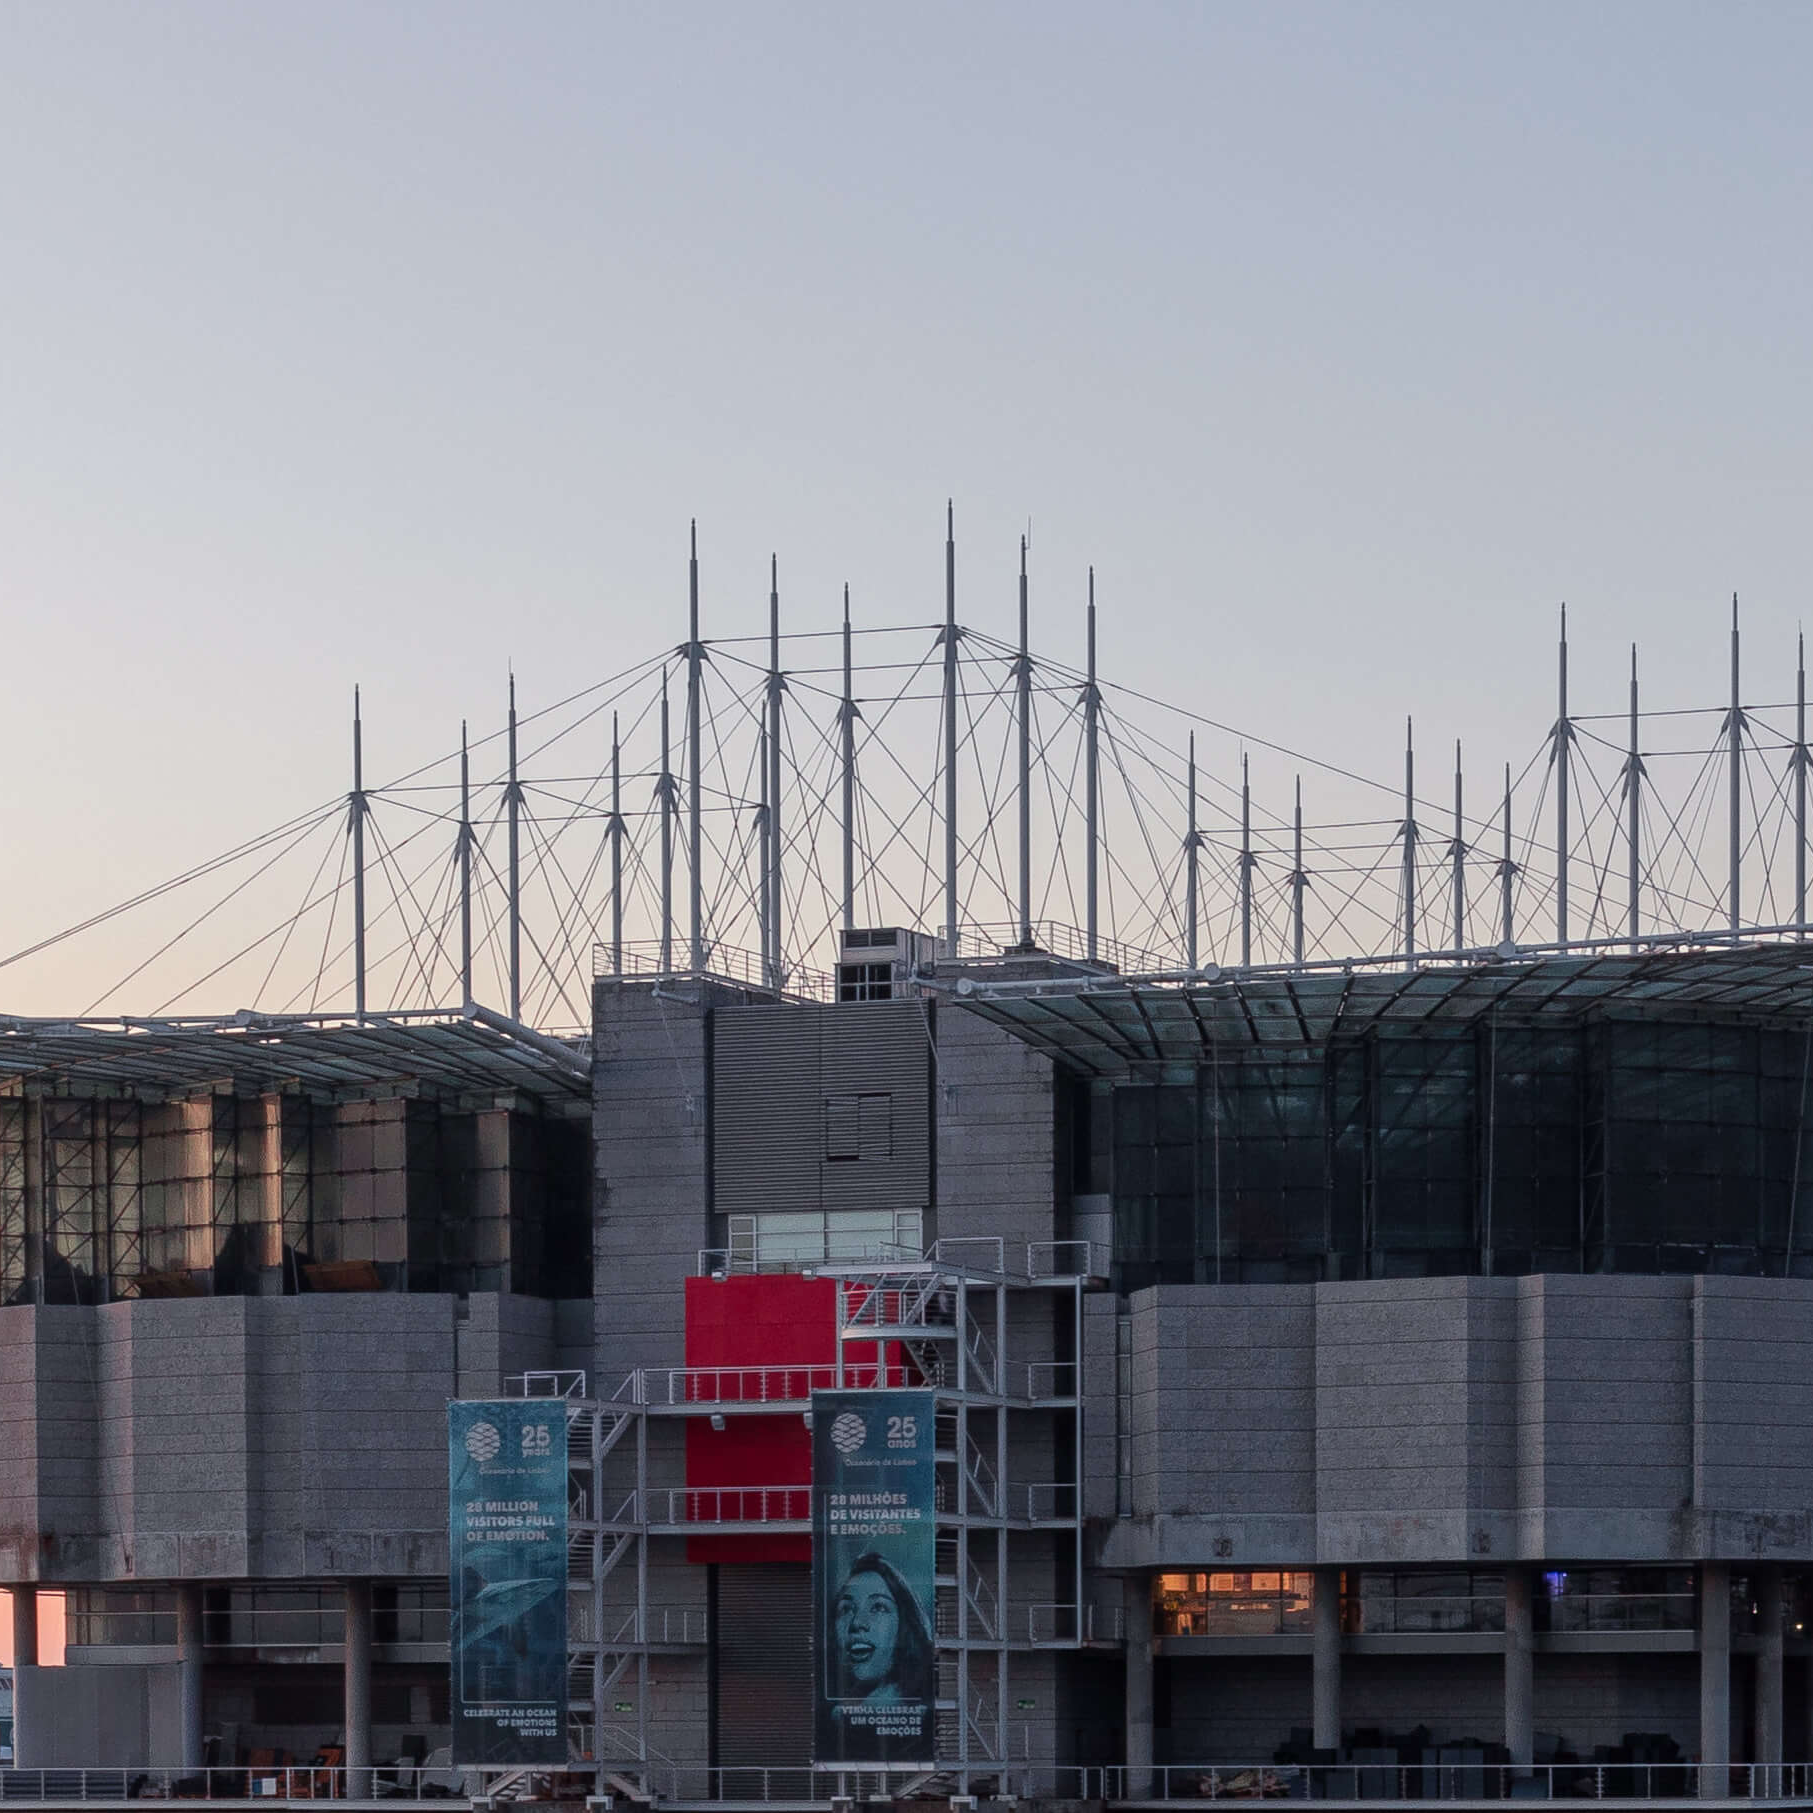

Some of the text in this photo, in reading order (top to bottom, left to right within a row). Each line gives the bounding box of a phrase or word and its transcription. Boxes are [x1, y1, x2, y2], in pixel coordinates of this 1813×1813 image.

[887, 1416, 917, 1438] 25
[522, 1425, 550, 1447] 25
[887, 1439, 917, 1448] anos
[522, 1448, 551, 1458] years
[830, 1491, 907, 1505] 28 MILHÕES
[467, 1502, 539, 1512] 28 MILLION
[830, 1509, 921, 1520] DE VISITANTES
[467, 1516, 555, 1526] VISITORS FULL
[830, 1521, 907, 1537] E EMOÇÕES.
[467, 1531, 550, 1541] OF EMOTION.
[463, 1709, 557, 1717] CELEBRATE AN OCEAN
[875, 1705, 922, 1714] CELEBRAR
[497, 1718, 557, 1727] OF EMOTIONS
[851, 1716, 921, 1725] UM OCEANO DE
[519, 1728, 557, 1737] WITH US
[876, 1726, 922, 1736] EMOÇÕES
